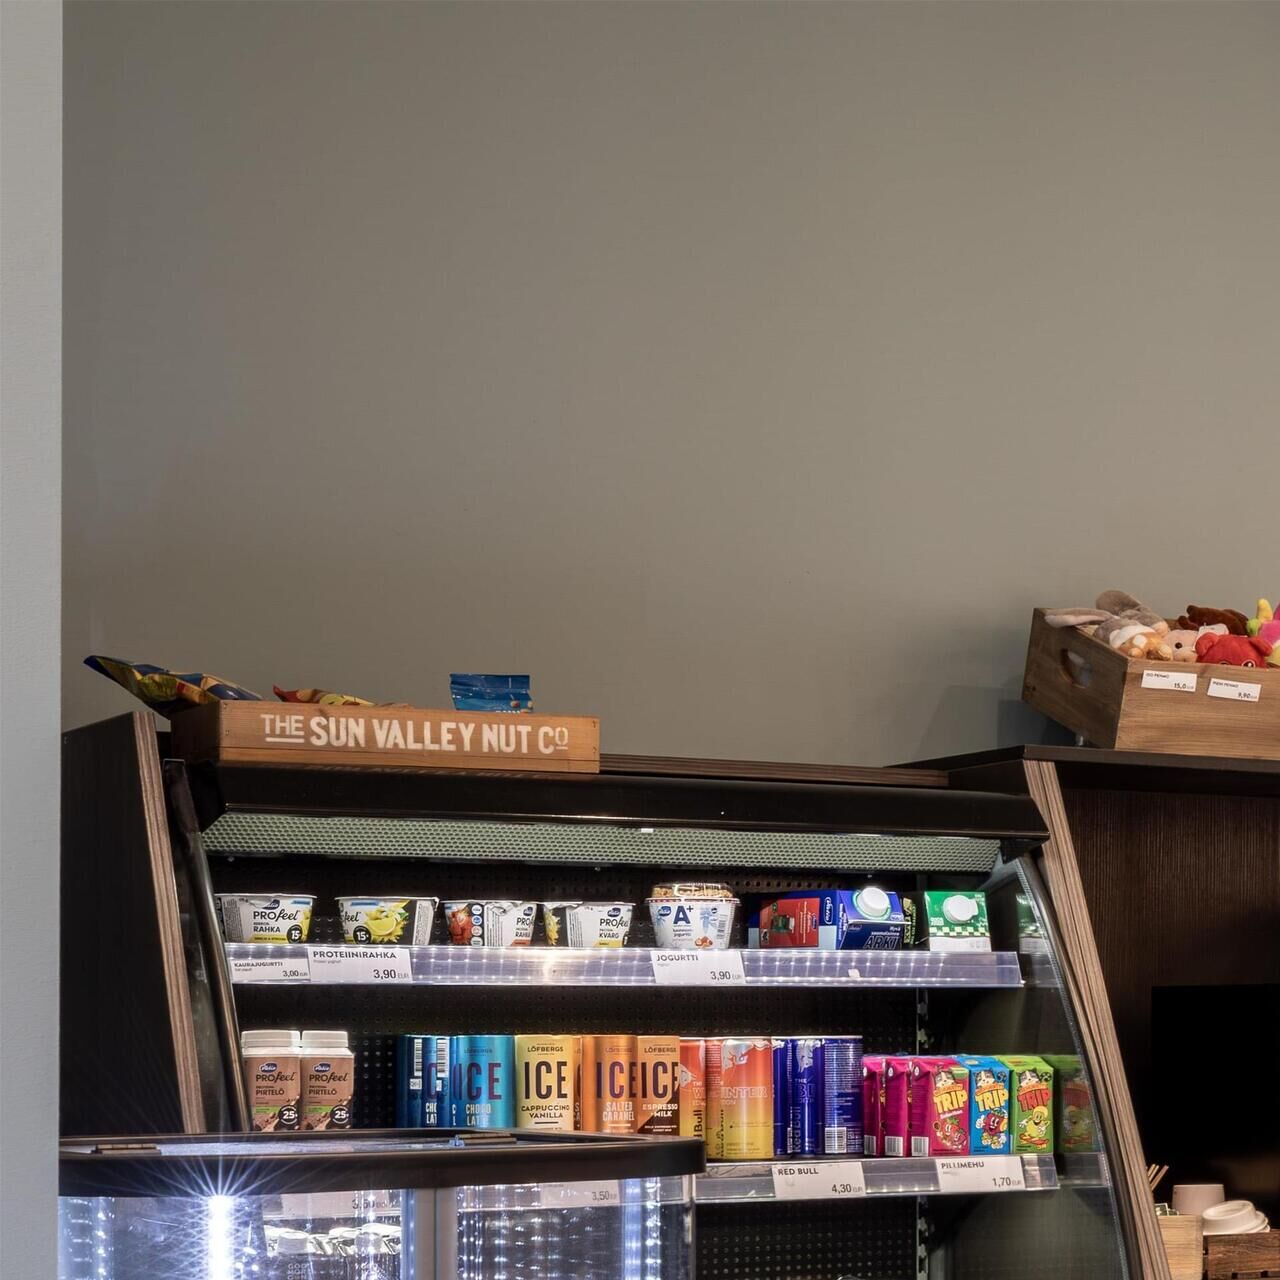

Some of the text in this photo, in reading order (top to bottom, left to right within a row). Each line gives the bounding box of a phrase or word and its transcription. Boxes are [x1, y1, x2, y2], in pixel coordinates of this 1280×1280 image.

[260, 714, 305, 736] THE
[309, 716, 365, 749] SUN
[373, 718, 475, 752] VALLEY
[481, 723, 532, 753] NUT
[313, 951, 397, 960] PROTEIINIRAHKA
[656, 954, 699, 962] JOGURTTI
[282, 970, 299, 978] 3,00
[373, 969, 397, 980] 3,90
[710, 971, 731, 981] 3,90
[524, 1061, 568, 1100] ICE
[596, 1061, 638, 1099] ICE
[720, 1086, 768, 1099] INTER
[933, 1090, 969, 1114] TRIP
[975, 1088, 1010, 1112] TRIP
[1017, 1089, 1051, 1113] TRIP
[606, 1101, 633, 1112] SALTED
[642, 1103, 678, 1112] ESPRESSO
[602, 1110, 635, 1121] CARAMEL
[941, 1161, 985, 1169] PILLIMEHU
[778, 1167, 819, 1176] RED BULL
[992, 1178, 1011, 1187] 1,70
[831, 1184, 852, 1194] 4,30
[591, 1190, 610, 1201] 3,50
